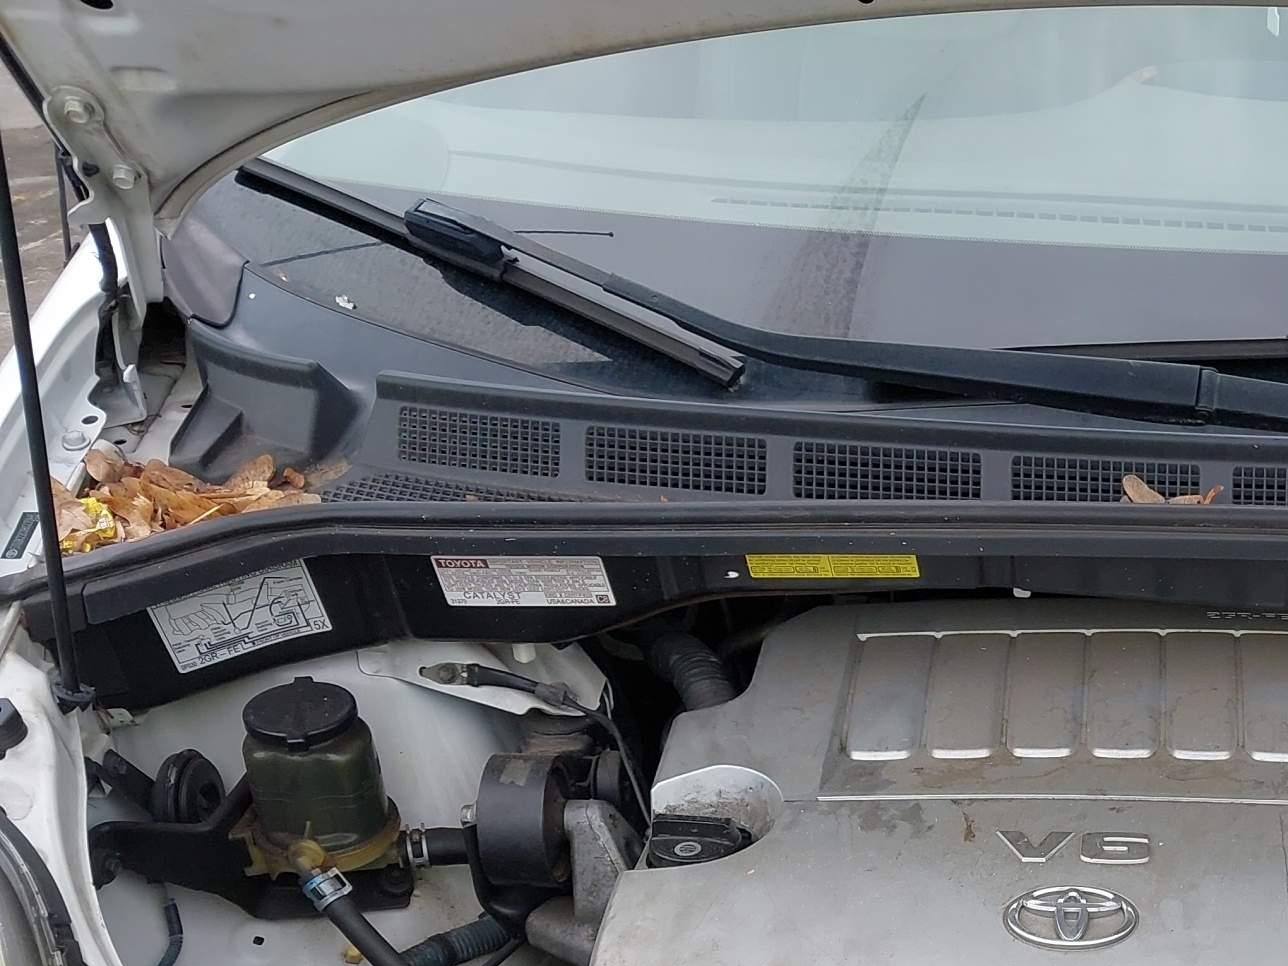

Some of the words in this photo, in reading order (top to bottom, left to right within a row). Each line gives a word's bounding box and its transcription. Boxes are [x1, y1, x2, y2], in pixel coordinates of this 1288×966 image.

[438, 559, 486, 568] TOYOTA
[463, 592, 522, 600] CATALYST
[313, 619, 331, 631] 5X
[996, 830, 1150, 864] V6
